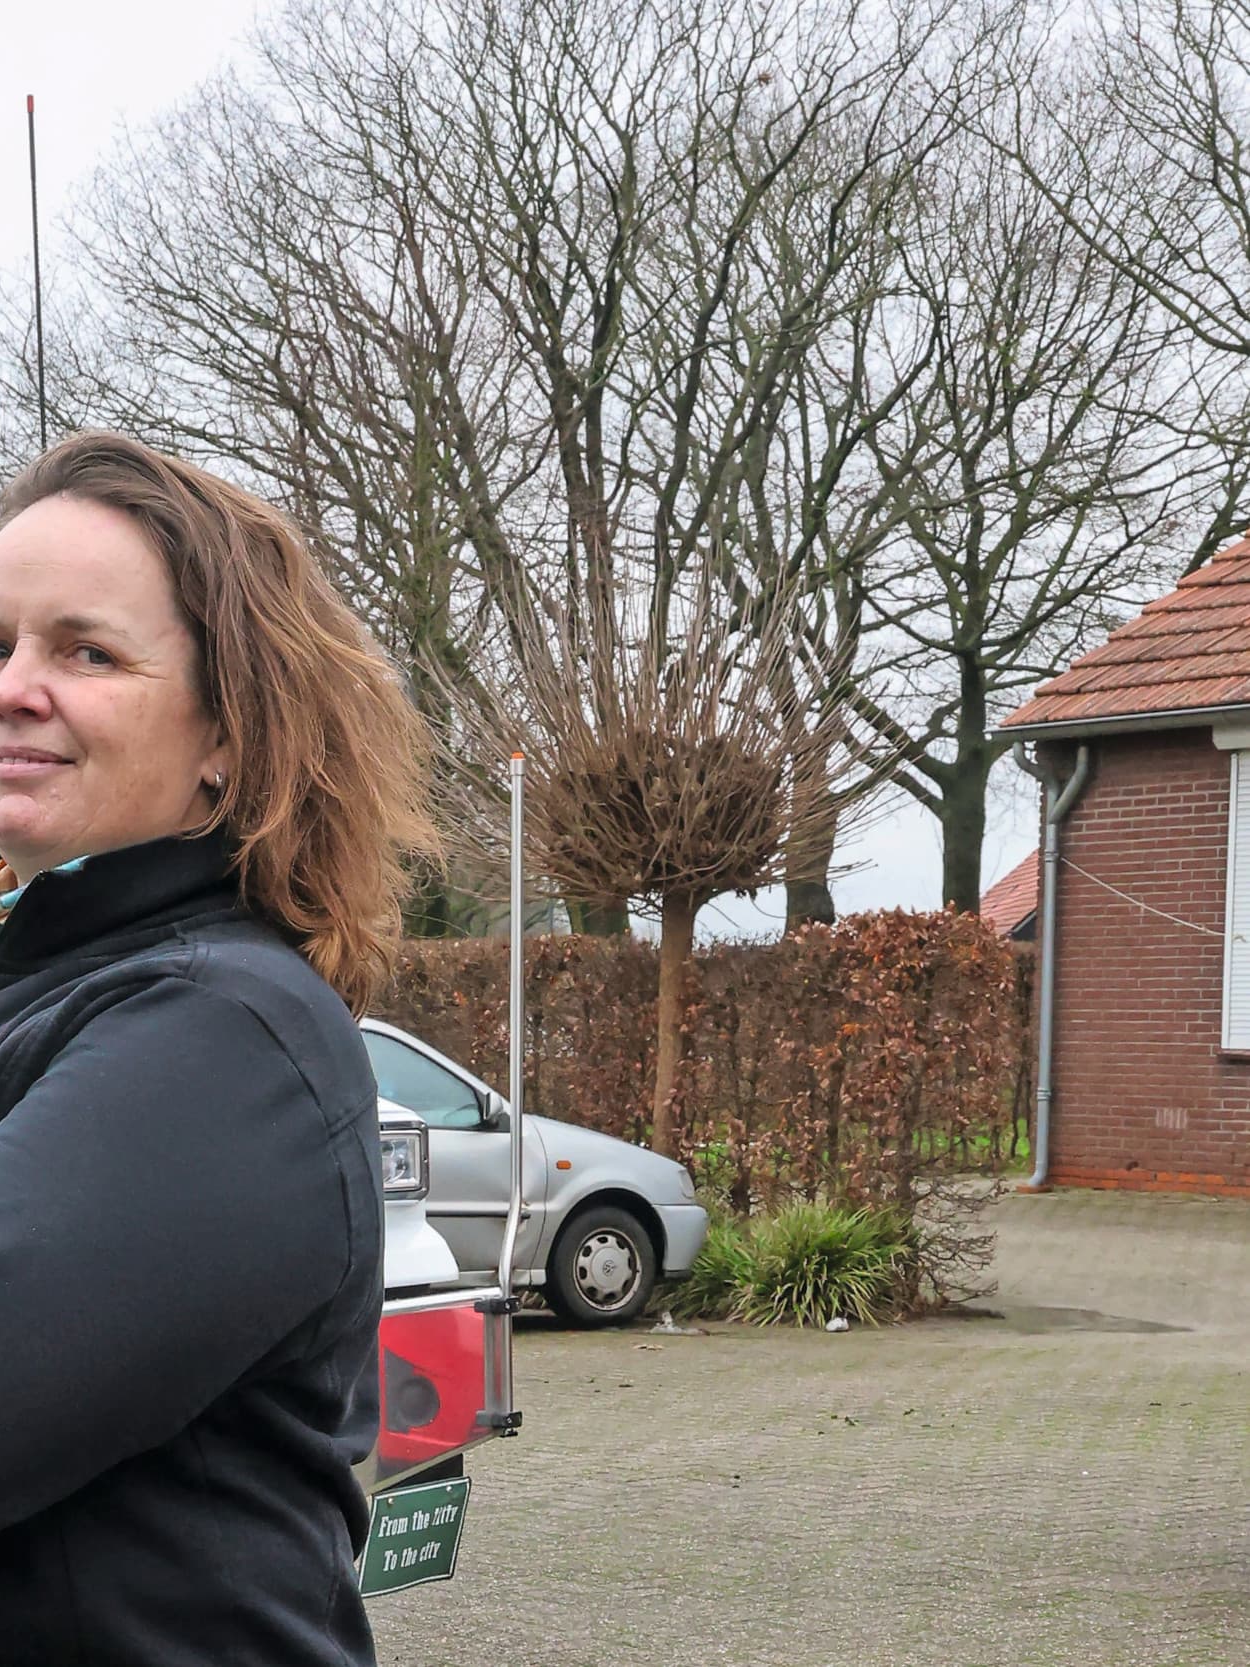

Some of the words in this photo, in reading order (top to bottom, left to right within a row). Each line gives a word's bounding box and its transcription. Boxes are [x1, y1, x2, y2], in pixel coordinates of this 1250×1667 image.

[378, 1516, 408, 1537] From
[412, 1510, 430, 1531] the
[383, 1549, 398, 1571] To
[401, 1547, 418, 1567] the
[419, 1541, 441, 1562] city
